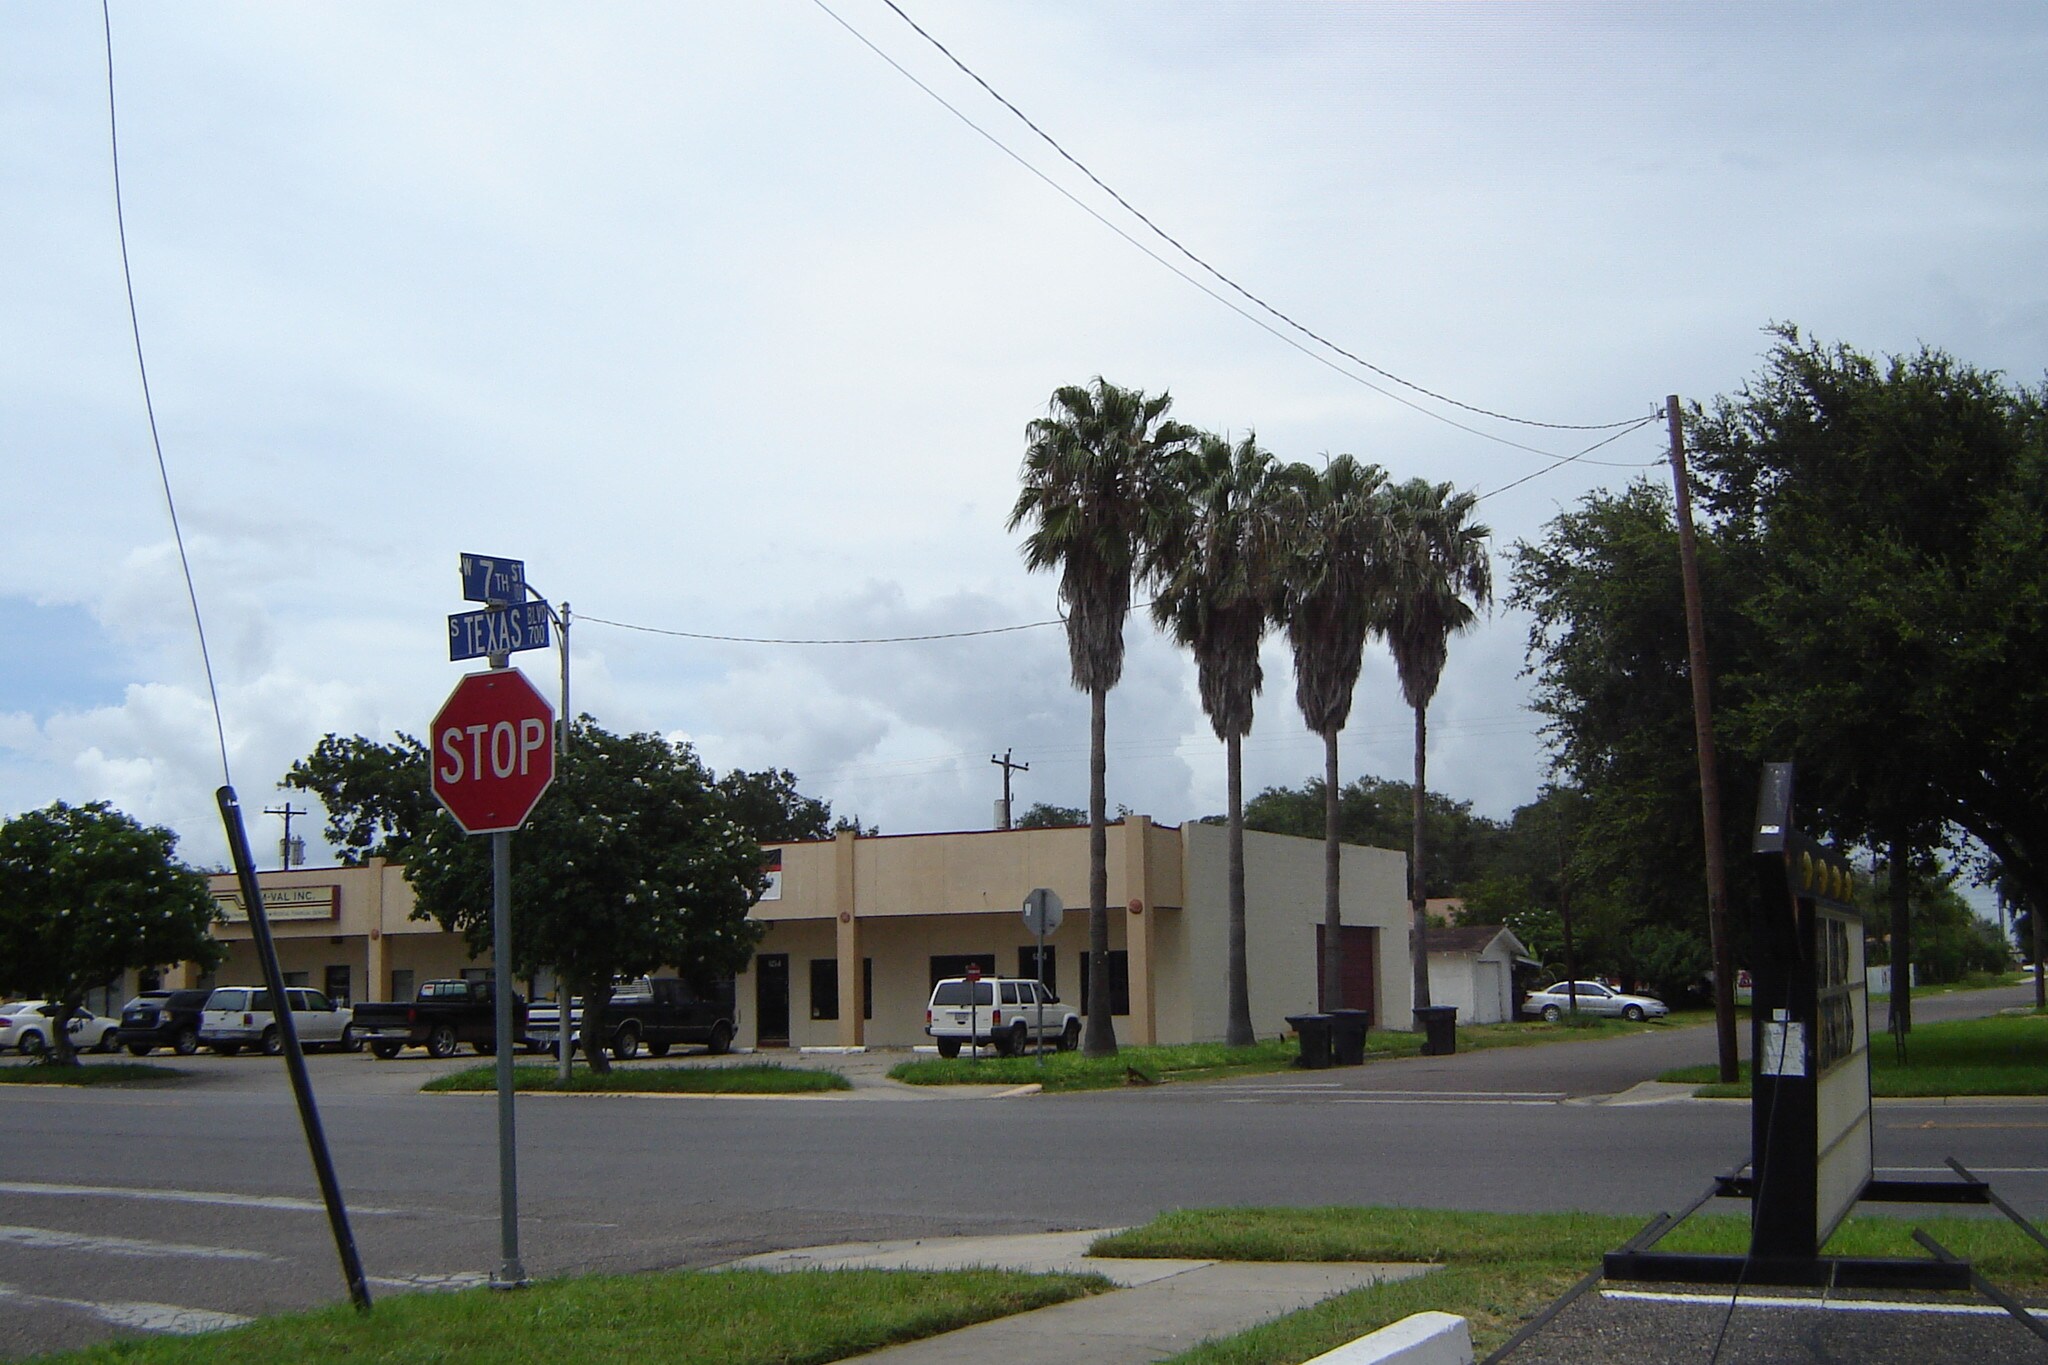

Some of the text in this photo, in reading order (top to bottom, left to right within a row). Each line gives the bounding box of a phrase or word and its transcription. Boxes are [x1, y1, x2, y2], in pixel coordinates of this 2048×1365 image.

[462, 557, 473, 577] W
[511, 563, 523, 583] ST
[450, 604, 547, 655] S TEXAS BLVD
[527, 624, 545, 644] 700
[440, 718, 545, 784] STOP
